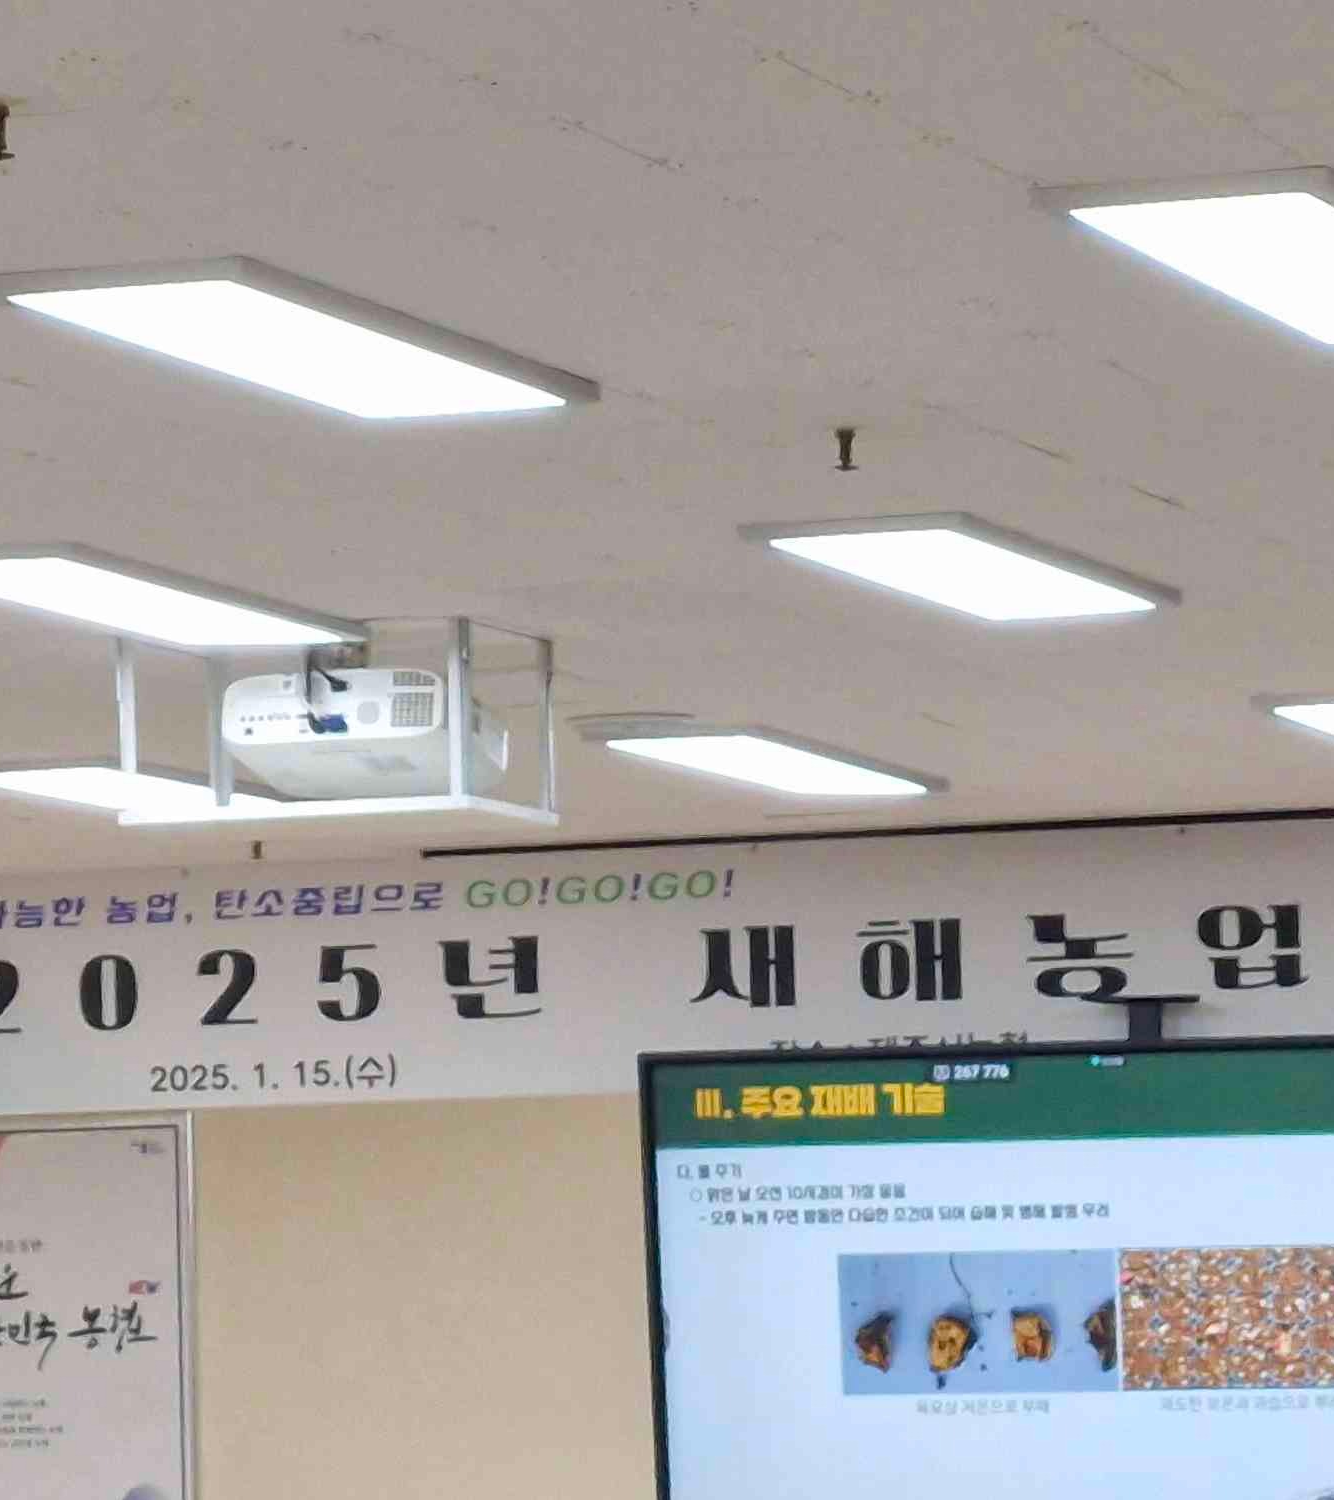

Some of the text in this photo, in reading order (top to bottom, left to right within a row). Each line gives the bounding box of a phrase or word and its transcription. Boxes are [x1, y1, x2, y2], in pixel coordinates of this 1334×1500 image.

[106, 891, 192, 925] 농업,
[214, 881, 443, 921] 탄소중립으로
[466, 869, 734, 909] GO!GO!GO!
[150, 1053, 396, 1093] 2025. 1. 15.(수)
[740, 1085, 804, 1120] 주요
[810, 1083, 876, 1118] 재배
[881, 1081, 947, 1117] 기술
[710, 1210, 736, 1226] 오후
